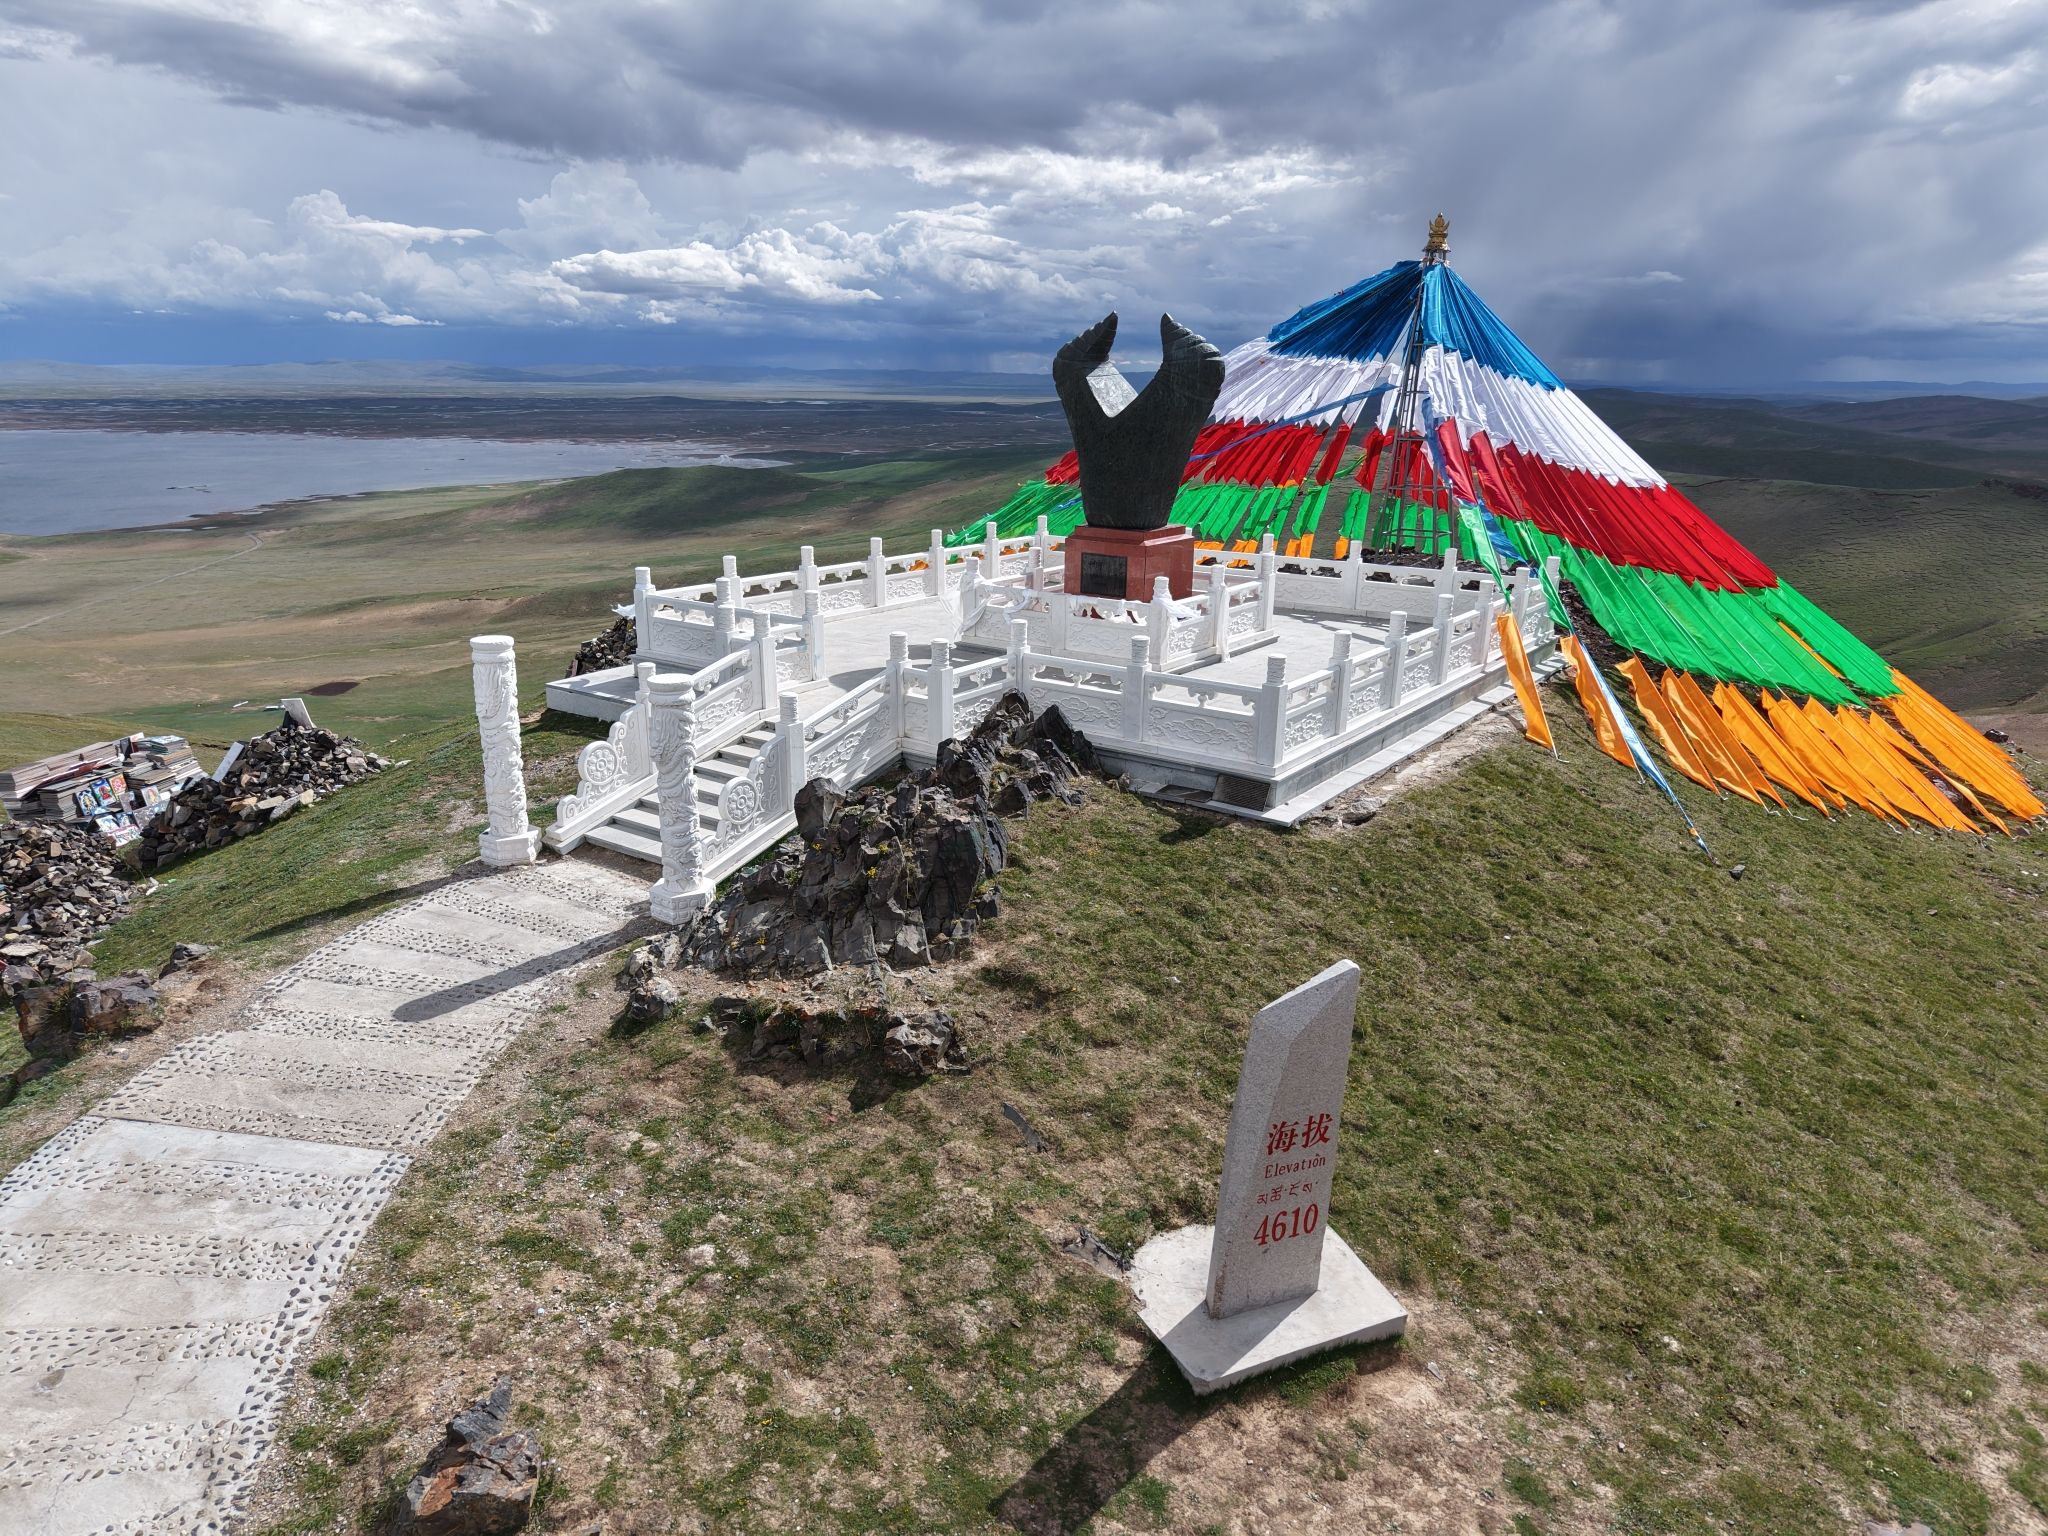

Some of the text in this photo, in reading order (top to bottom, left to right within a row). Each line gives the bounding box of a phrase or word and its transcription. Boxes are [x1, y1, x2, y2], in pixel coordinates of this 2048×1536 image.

[1267, 1113, 1333, 1155] 海拔
[1264, 1154, 1326, 1179] Elevation
[1253, 1203, 1319, 1246] 4610
